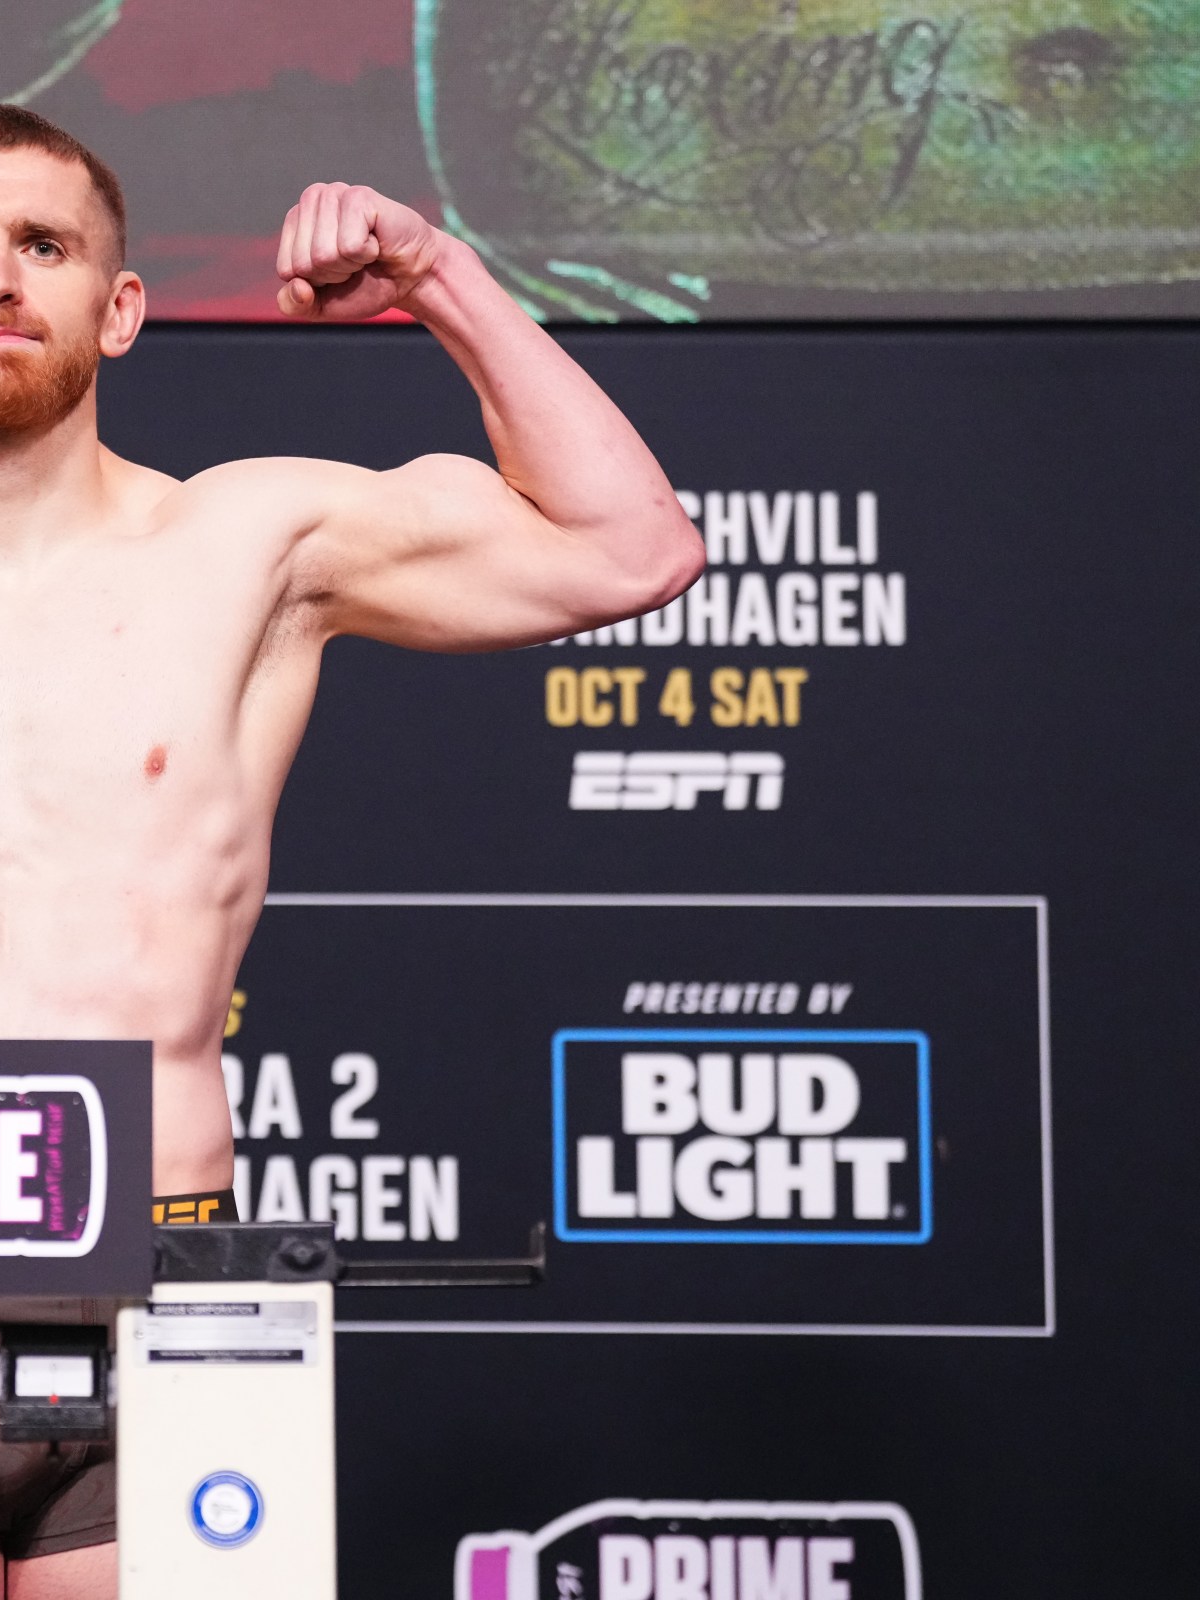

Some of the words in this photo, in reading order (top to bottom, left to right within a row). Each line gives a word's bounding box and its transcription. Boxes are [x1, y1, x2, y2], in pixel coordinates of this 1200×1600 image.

[545, 667, 646, 727] OCT
[659, 667, 695, 727] 4
[710, 667, 808, 727] SAT
[569, 751, 784, 810] ESPN
[622, 982, 799, 1014] PRESENTED
[807, 983, 853, 1014] BY
[330, 1052, 380, 1140] 2
[621, 1052, 861, 1136] BUD
[233, 1154, 460, 1241] AGEN
[576, 1135, 907, 1221] LIGHT
[599, 1535, 855, 1600] PRIME
